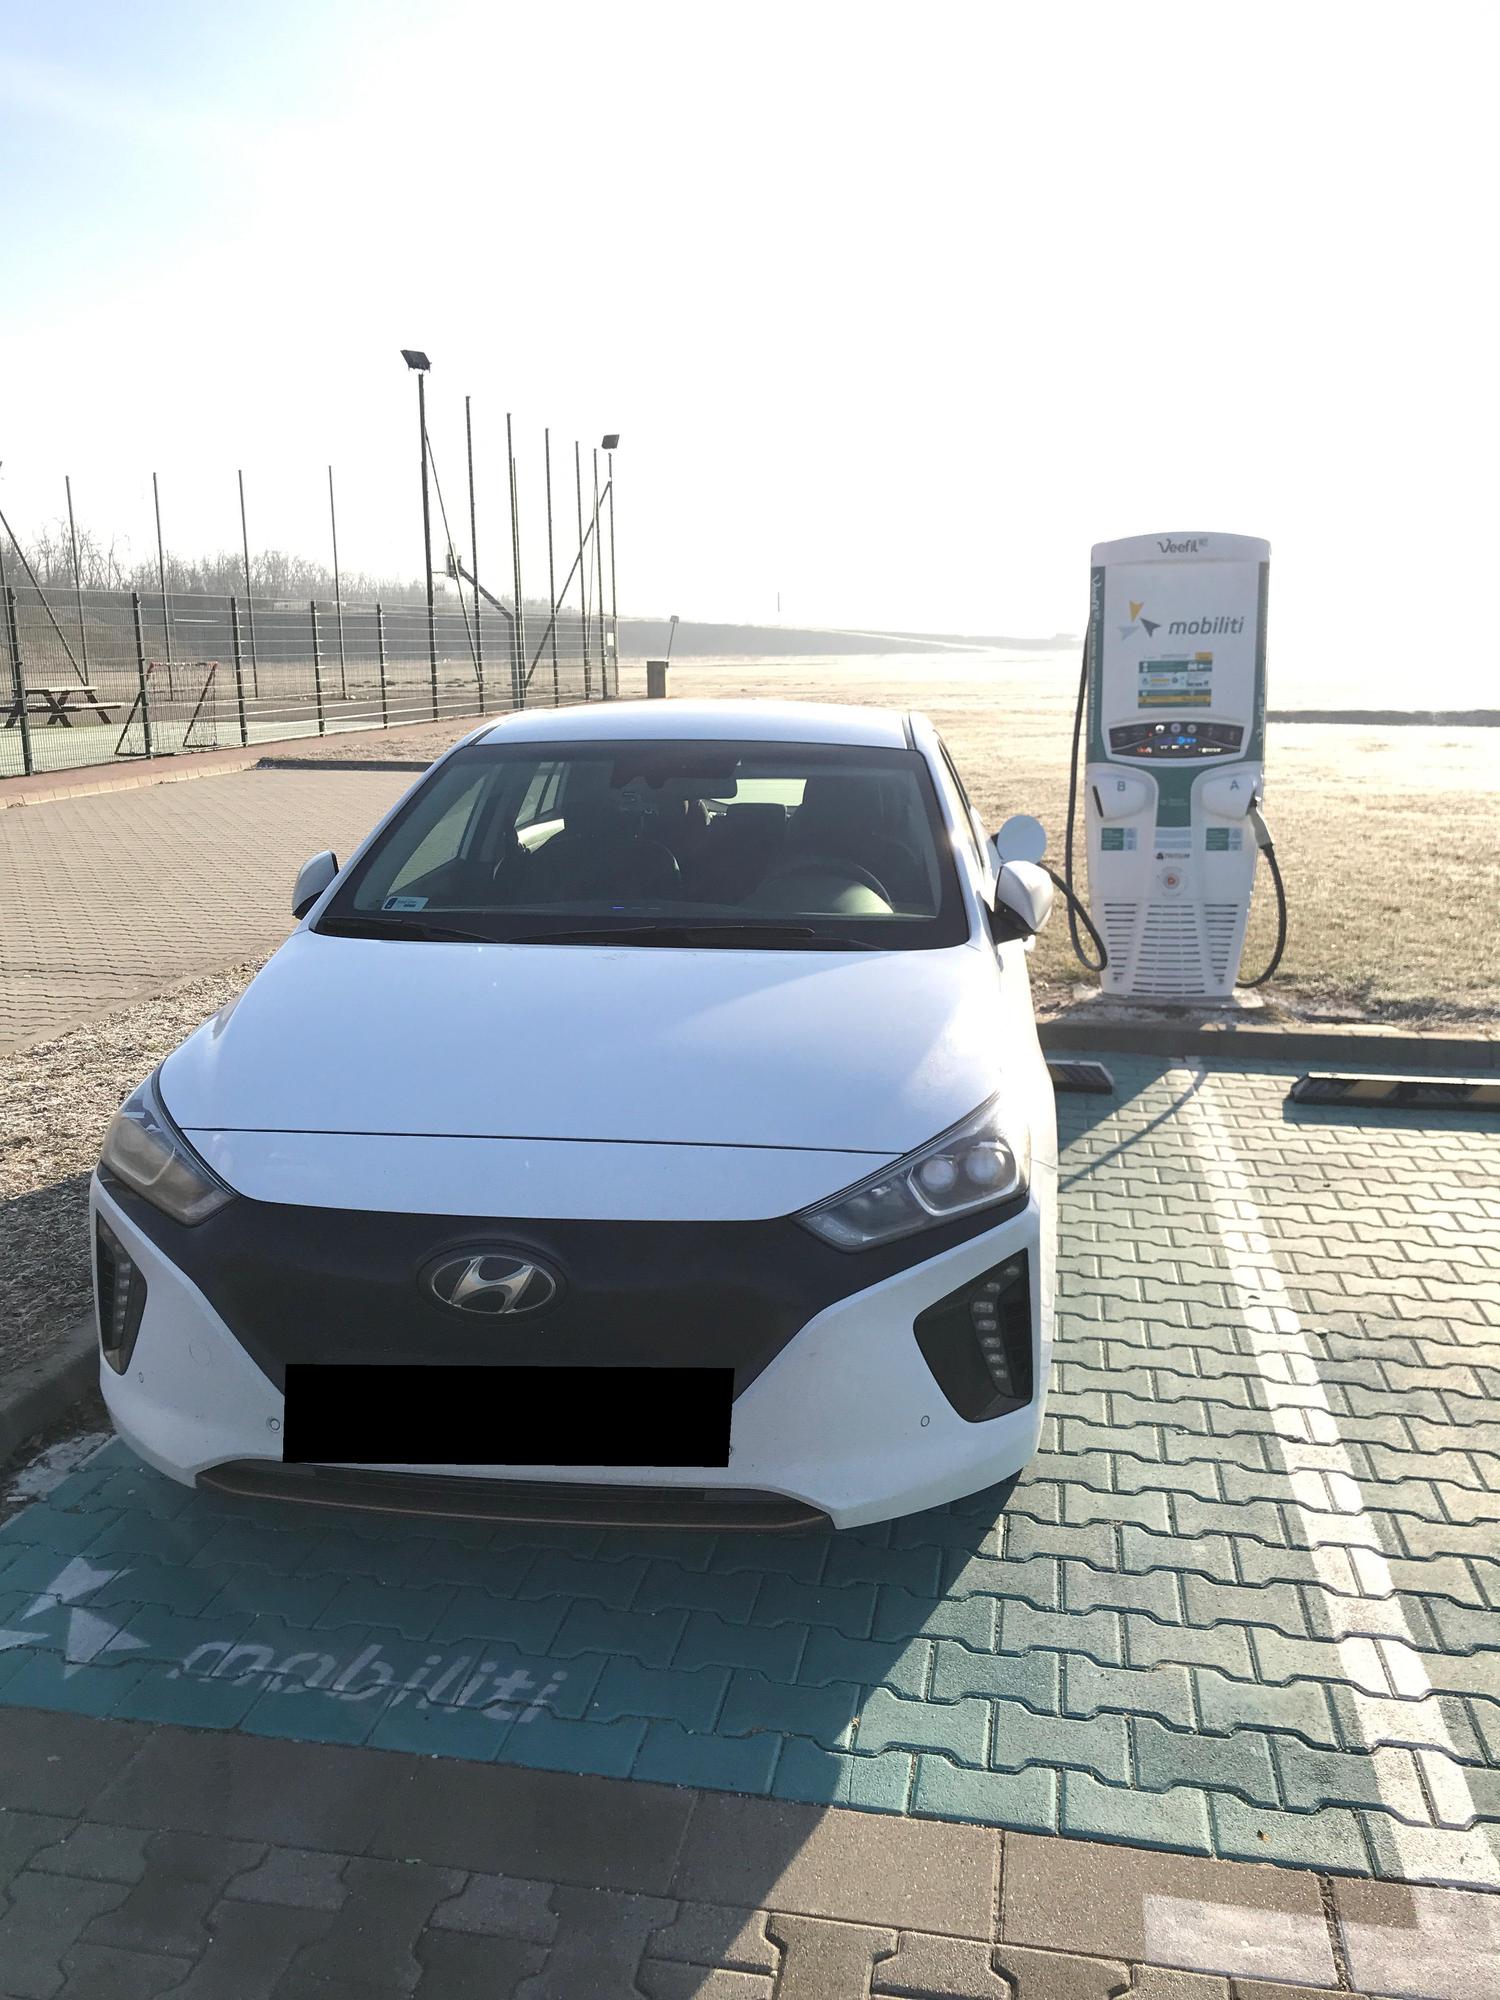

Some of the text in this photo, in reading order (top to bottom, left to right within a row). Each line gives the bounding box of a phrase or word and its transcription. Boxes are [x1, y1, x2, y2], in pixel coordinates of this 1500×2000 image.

[1157, 538, 1198, 553] Veefil
[1168, 616, 1245, 635] mobiliti
[1117, 781, 1125, 792] B
[1230, 779, 1240, 791] A
[166, 1640, 569, 1725] mobiliti
